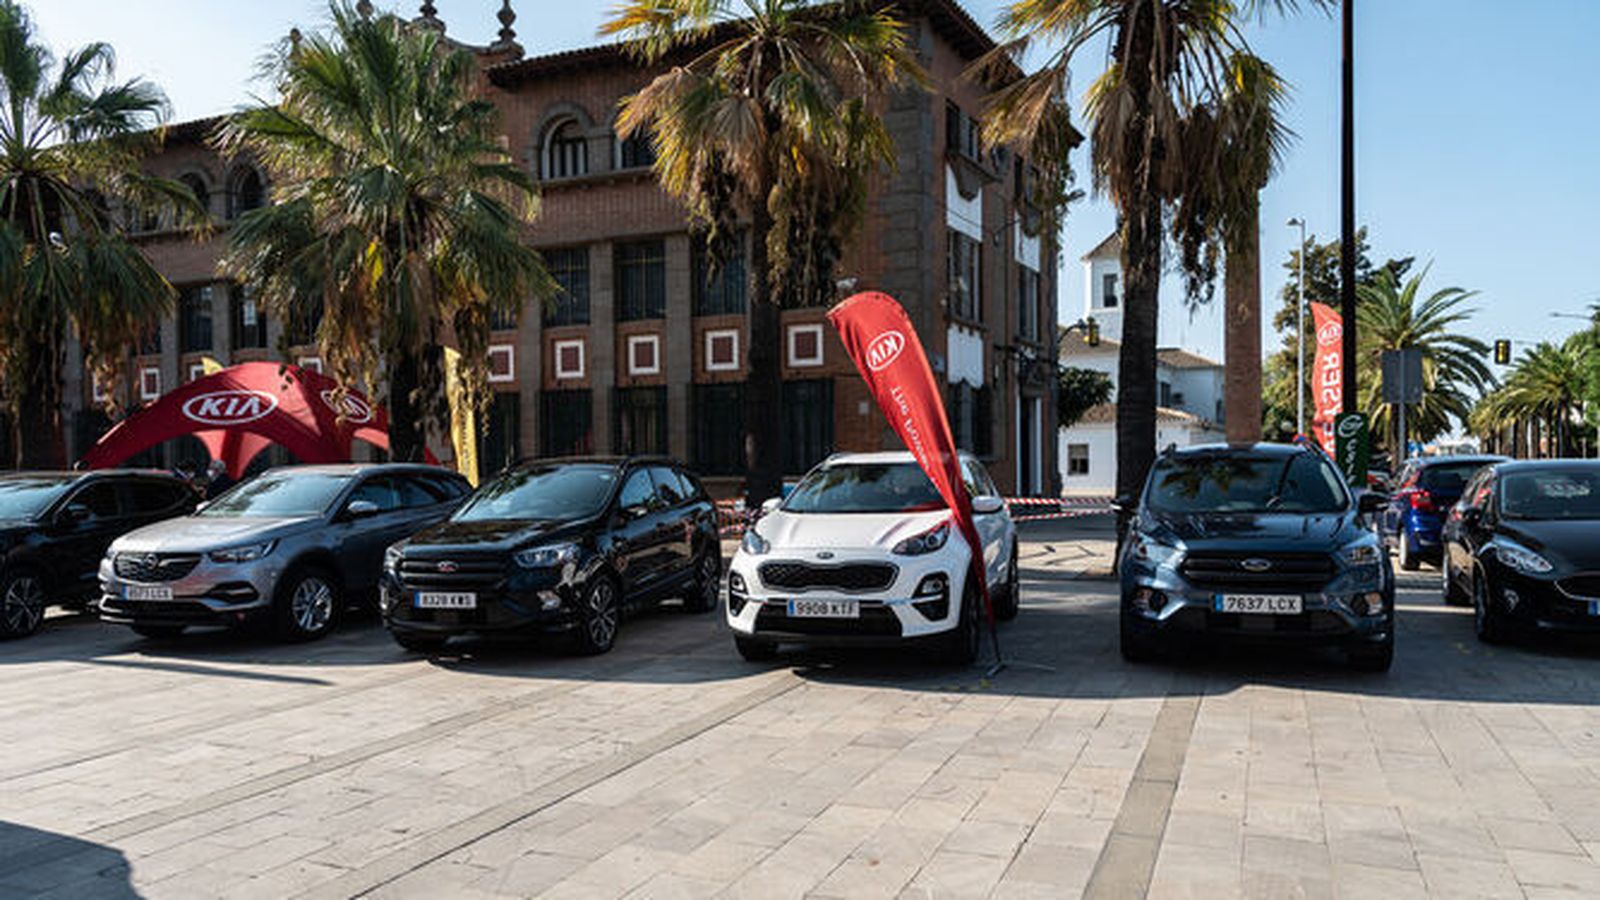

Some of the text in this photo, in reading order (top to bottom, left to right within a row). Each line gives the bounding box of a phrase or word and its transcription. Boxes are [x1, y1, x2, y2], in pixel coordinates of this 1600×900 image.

[198, 396, 261, 417] KIA
[1227, 596, 1297, 612] 7637 LCX
